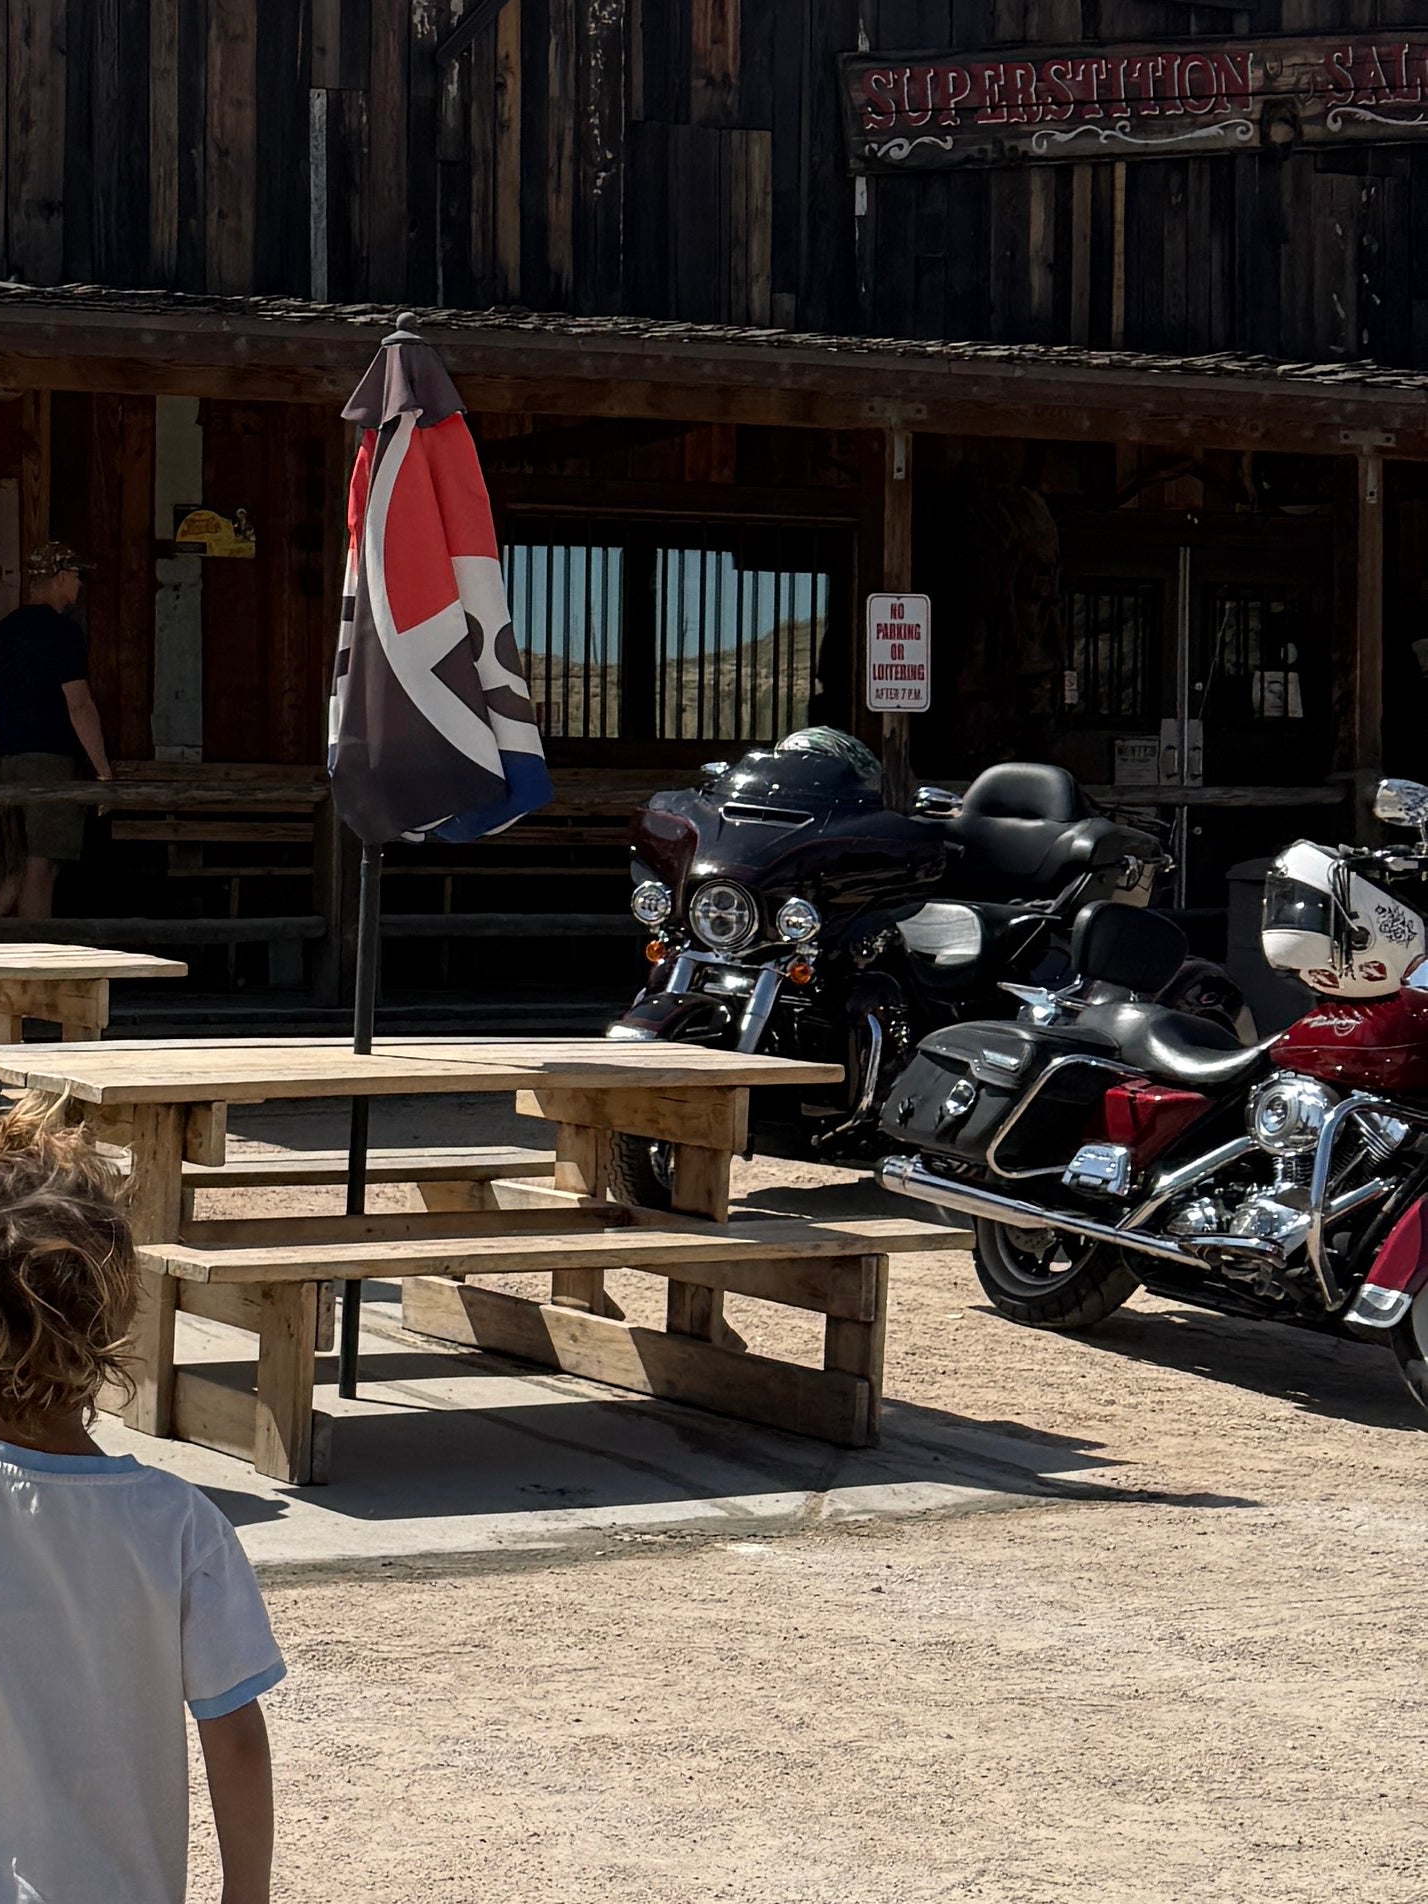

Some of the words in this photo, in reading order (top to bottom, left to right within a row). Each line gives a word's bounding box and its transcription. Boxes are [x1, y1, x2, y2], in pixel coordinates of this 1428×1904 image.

[863, 52, 1255, 129] SUPERSTITION
[1321, 43, 1428, 107] SAL
[890, 603, 904, 619] NO
[876, 623, 921, 641] PARKING
[890, 643, 904, 661] OR
[873, 664, 925, 681] LOITERING
